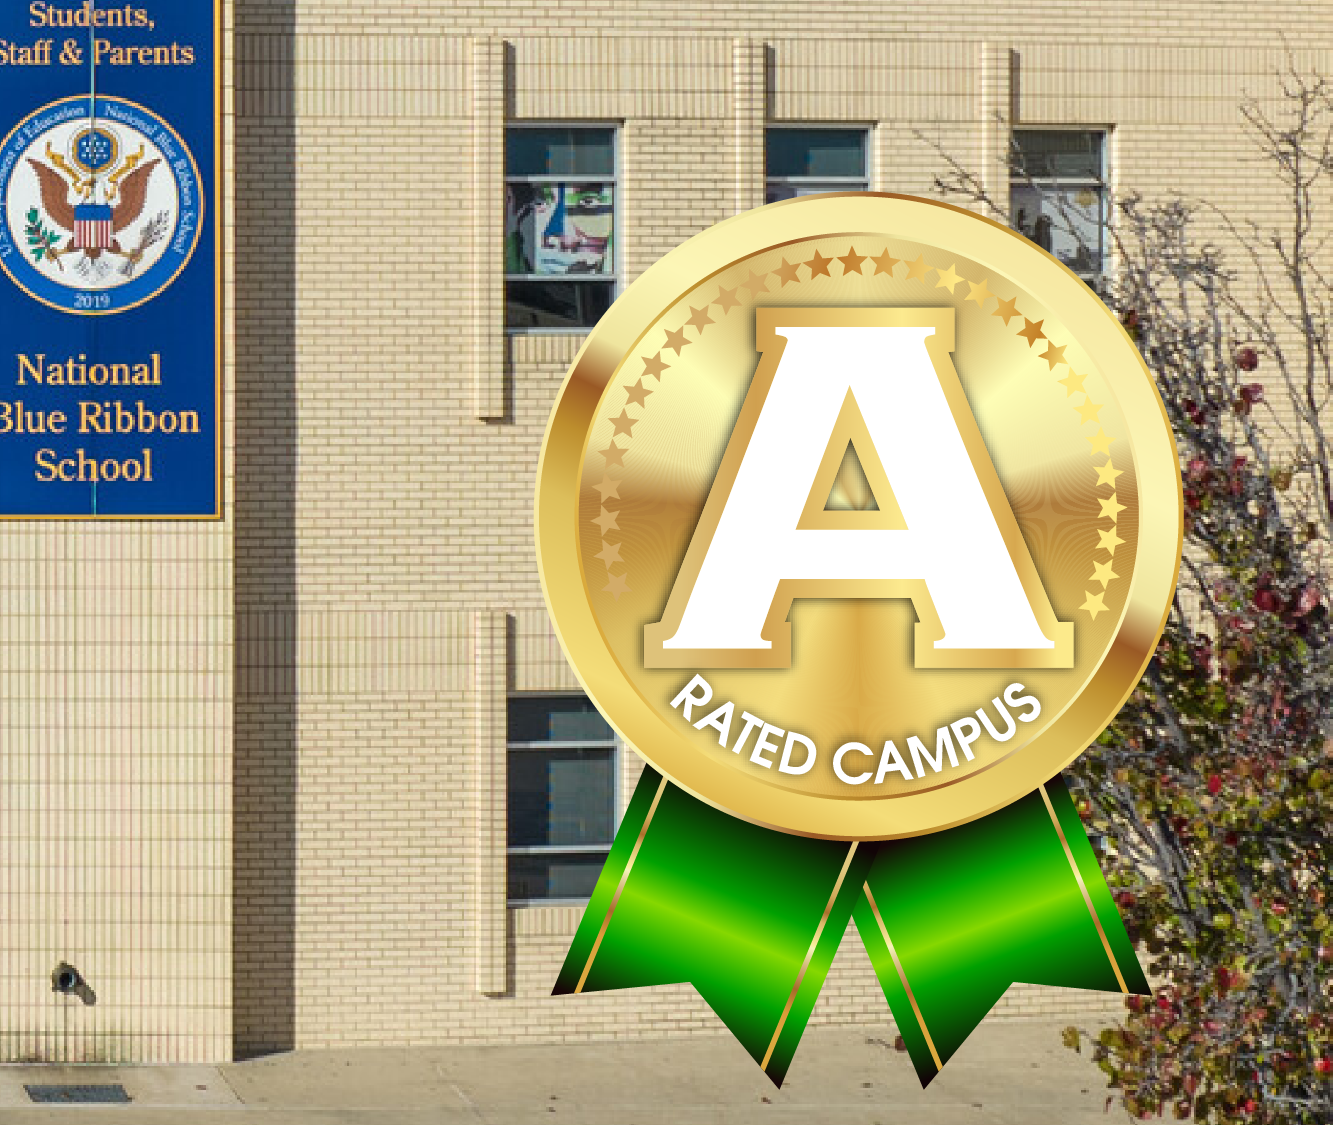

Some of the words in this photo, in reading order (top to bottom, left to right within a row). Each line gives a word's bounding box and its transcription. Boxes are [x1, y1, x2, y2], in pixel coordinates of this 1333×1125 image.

[29, 1, 155, 31] Students,
[58, 39, 83, 65] &
[93, 39, 195, 65] Parents
[74, 293, 110, 309] 2019
[16, 351, 161, 386] National
[78, 400, 199, 433] Ribbon
[35, 448, 152, 482] School
